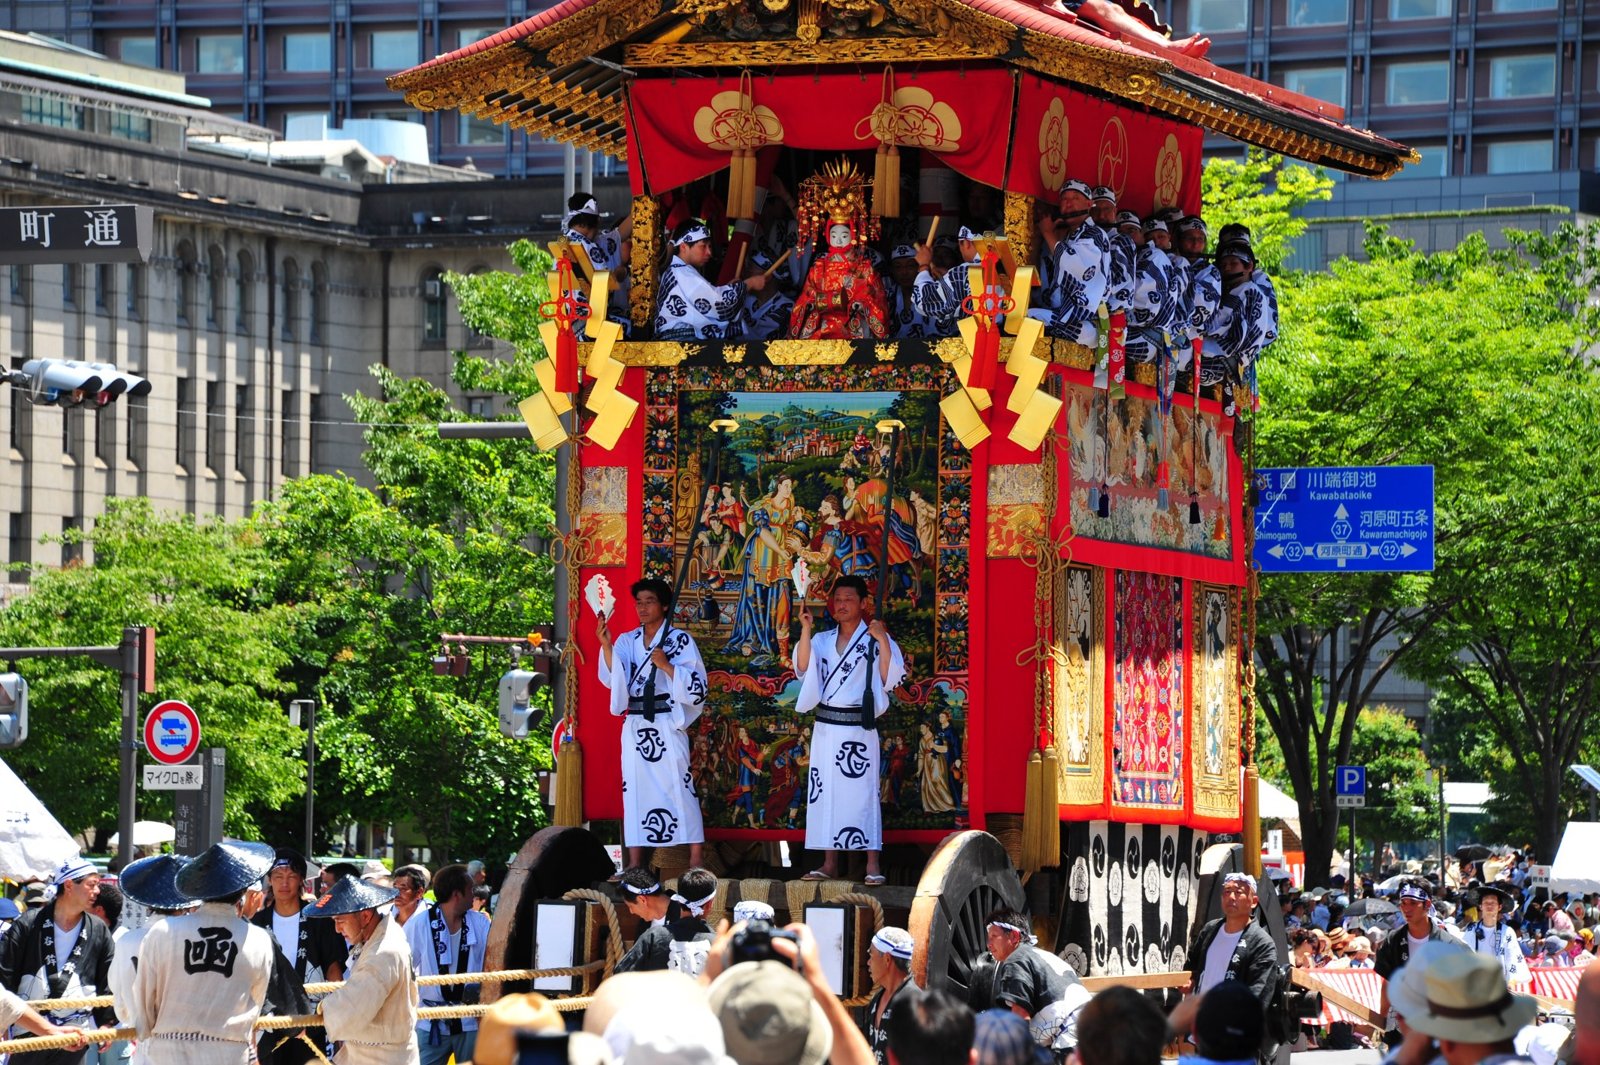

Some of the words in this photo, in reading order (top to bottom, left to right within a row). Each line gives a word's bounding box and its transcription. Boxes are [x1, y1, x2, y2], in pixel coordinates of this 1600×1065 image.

[19, 208, 121, 248] 町通
[1307, 471, 1377, 488] 川端御池
[1265, 491, 1287, 501] Gion
[1310, 490, 1372, 500] Kawabataoike
[1256, 511, 1295, 529] 下鴨
[1360, 509, 1429, 528] 河原町五条
[1255, 531, 1297, 541] Shimogamo
[1360, 529, 1427, 541] Kawaramachigojo
[1335, 523, 1347, 535] 37
[1289, 545, 1301, 557] 32
[1320, 545, 1363, 557] 河原町通
[1384, 545, 1396, 556] 32
[146, 771, 199, 785] マイクロを除く
[1344, 769, 1360, 791] P
[177, 804, 189, 848] 寺町通
